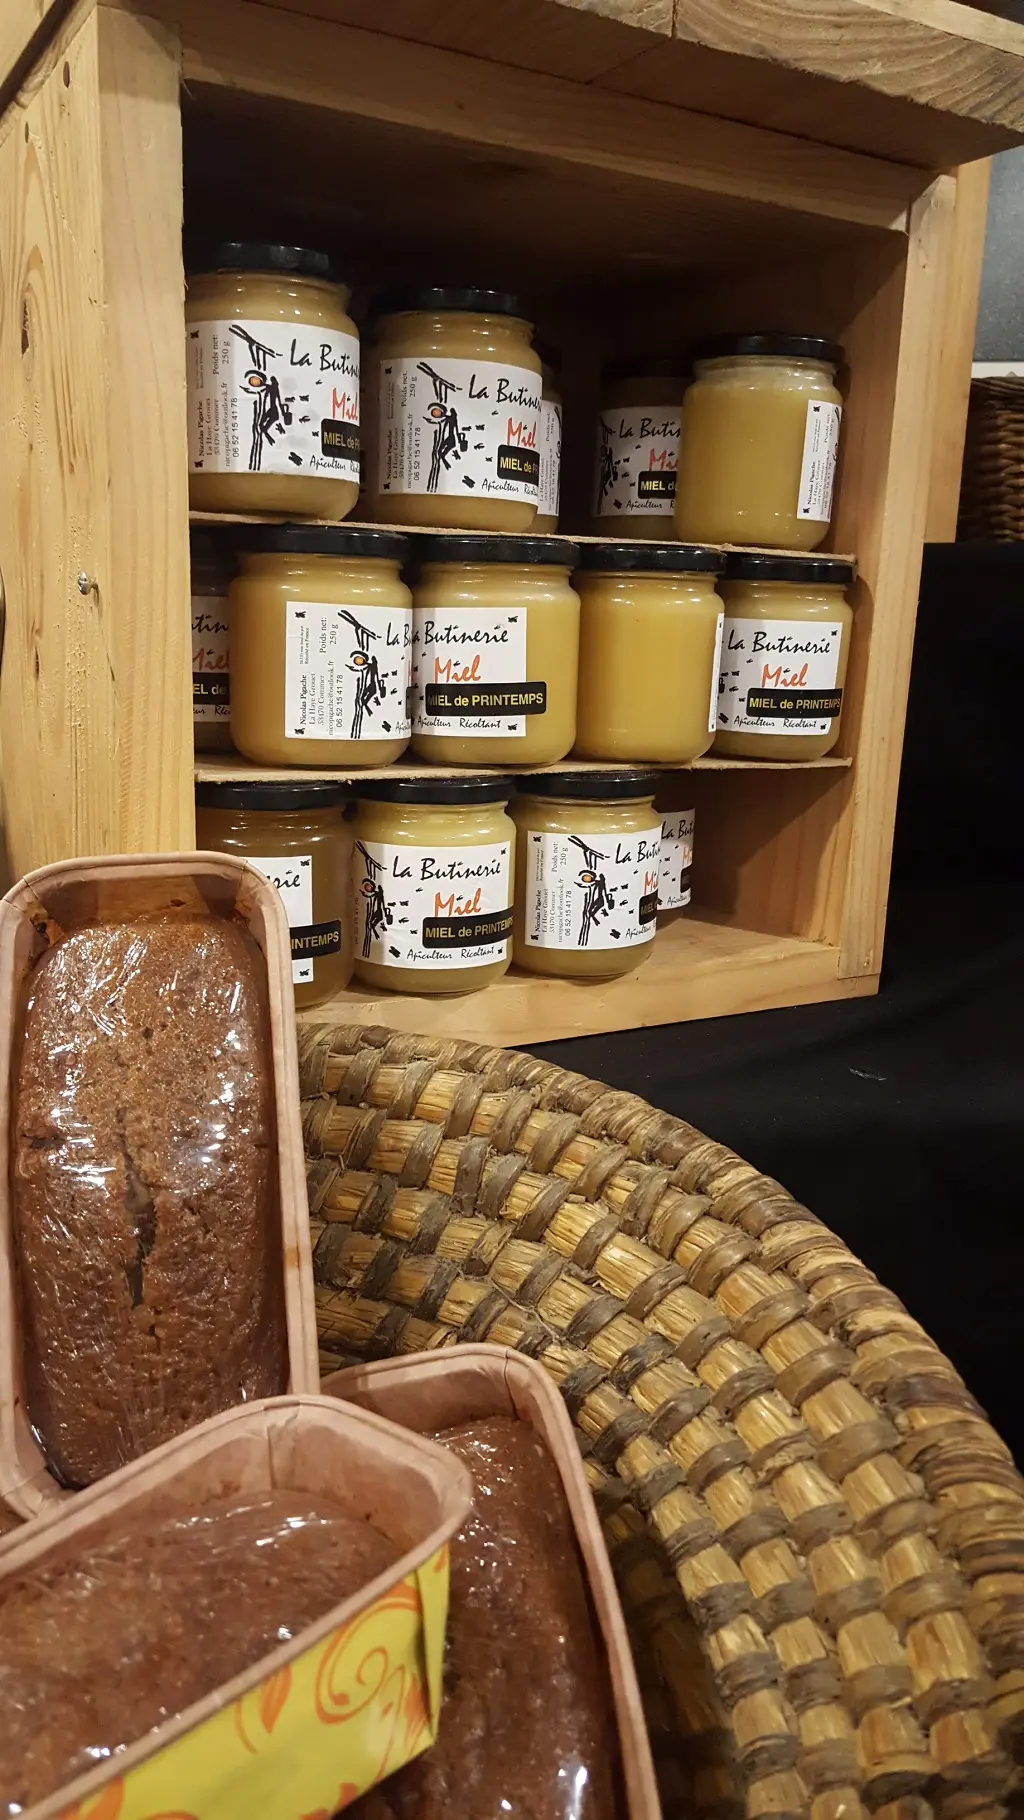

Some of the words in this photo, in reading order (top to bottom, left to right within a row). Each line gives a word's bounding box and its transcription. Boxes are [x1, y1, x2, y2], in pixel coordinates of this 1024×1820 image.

[290, 338, 312, 366] La
[468, 374, 490, 399] La
[231, 398, 238, 408] 78
[332, 388, 358, 420] Miel
[232, 411, 238, 420] 41
[232, 423, 239, 432] 15
[415, 428, 421, 436] 78
[506, 418, 537, 448] Miel
[620, 419, 633, 439] La
[232, 436, 239, 445] 52
[324, 432, 346, 447] MIEL
[347, 436, 355, 449] de
[415, 439, 421, 448] 41
[233, 448, 240, 458] 06
[414, 450, 420, 458] 15
[310, 455, 347, 471] Apiculteur
[414, 461, 420, 470] 52
[500, 457, 523, 472] MIEL
[524, 461, 532, 473] de
[414, 472, 420, 481] 06
[482, 478, 520, 494] Apiculteur
[640, 480, 666, 491] MIEL
[668, 481, 677, 491] d
[626, 499, 663, 511] Apiculteur
[386, 622, 400, 646] La
[425, 621, 509, 645] Butinerie
[319, 633, 327, 653] Poids
[728, 629, 745, 650] La
[752, 631, 831, 654] Butinerie
[434, 654, 481, 684] Miel
[761, 663, 808, 688] Miel
[337, 674, 343, 684] 78
[300, 674, 308, 700] Pigache
[336, 686, 343, 695] 41
[309, 698, 317, 715] Haye
[336, 697, 343, 705] 15
[428, 695, 452, 707] MIEL
[454, 696, 469, 707] de
[472, 693, 544, 707] PRINTEMPS
[749, 698, 777, 709] MIEL
[780, 700, 794, 710] de
[796, 698, 840, 710] PRINTEMPS
[336, 708, 343, 717] 52
[309, 717, 316, 725] La
[336, 719, 343, 728] 06
[418, 716, 451, 729] Apiculteur
[460, 718, 502, 729] Récoltant
[734, 715, 776, 728] Apiculteur
[783, 718, 817, 728] Récoltant
[661, 821, 675, 840] La
[615, 843, 632, 865] La
[392, 856, 413, 879] La
[420, 858, 501, 881] Butinerie
[434, 887, 482, 918] Miel
[565, 919, 571, 927] 52
[426, 927, 456, 938] MIEL
[459, 926, 472, 938] de
[565, 929, 571, 937] 06
[407, 949, 453, 962] Apiculteur
[460, 946, 495, 959] Récoltant
